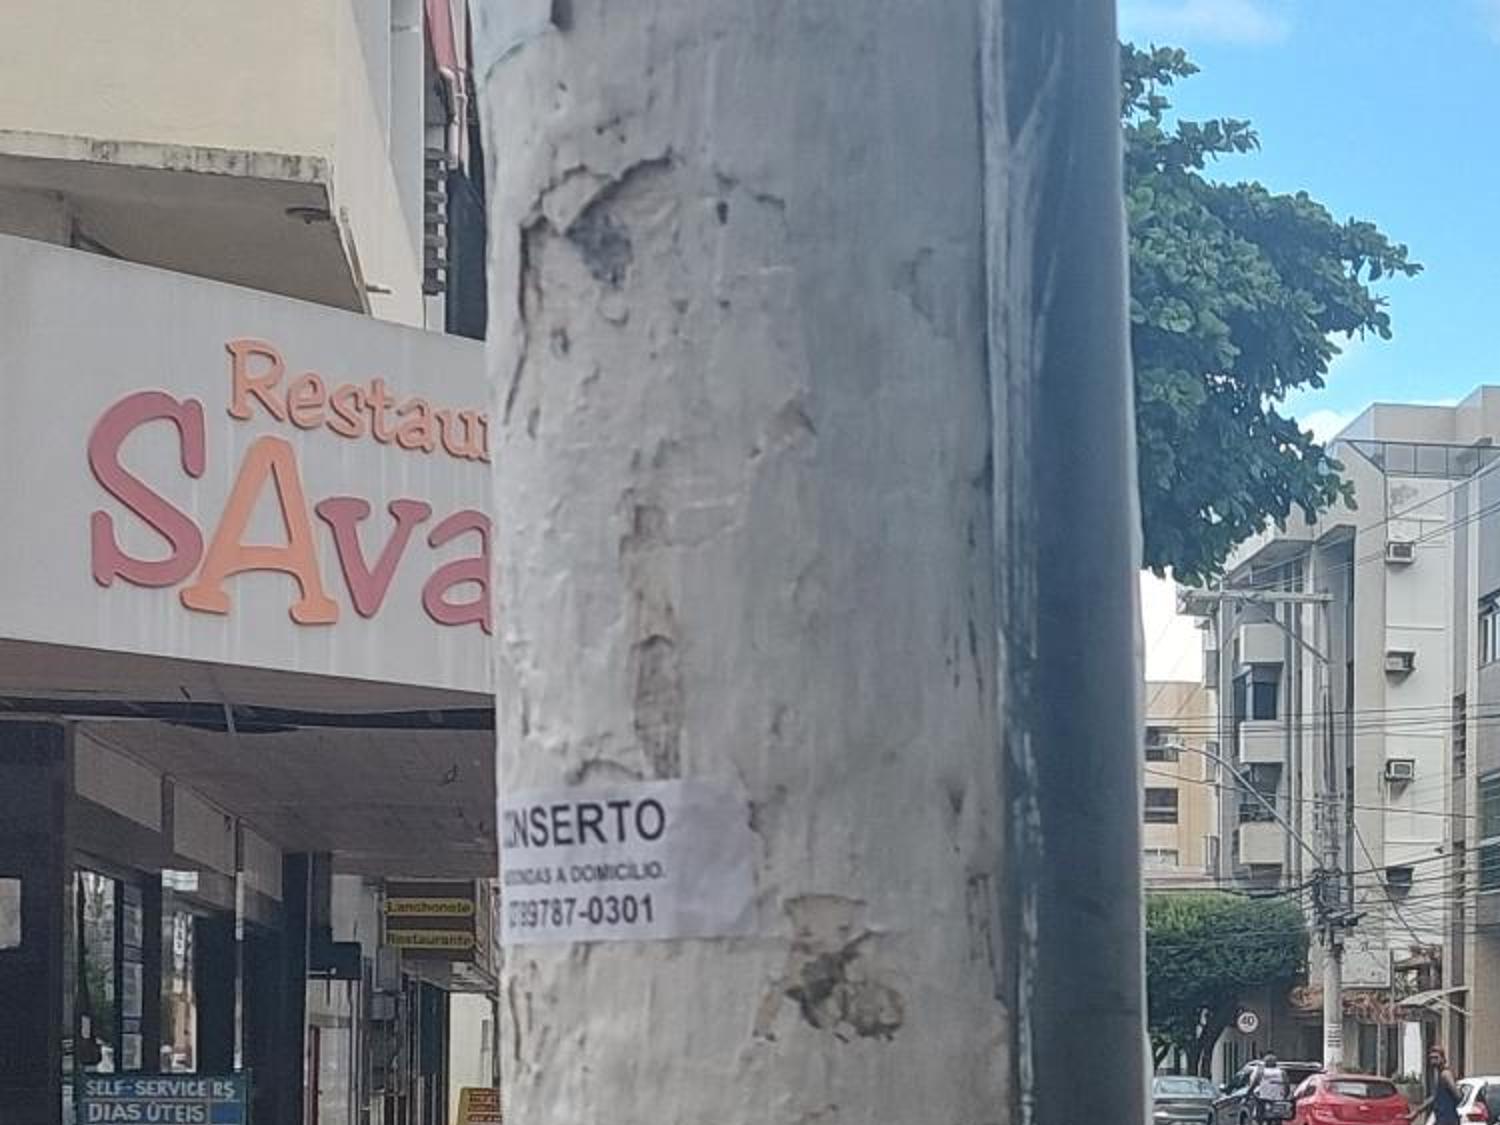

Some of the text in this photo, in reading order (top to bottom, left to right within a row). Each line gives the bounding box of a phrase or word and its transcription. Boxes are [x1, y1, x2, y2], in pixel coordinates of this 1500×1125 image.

[85, 1080, 207, 1097] SELF-SERVICE
[88, 1101, 205, 1122] DIAS ÚTEIS
